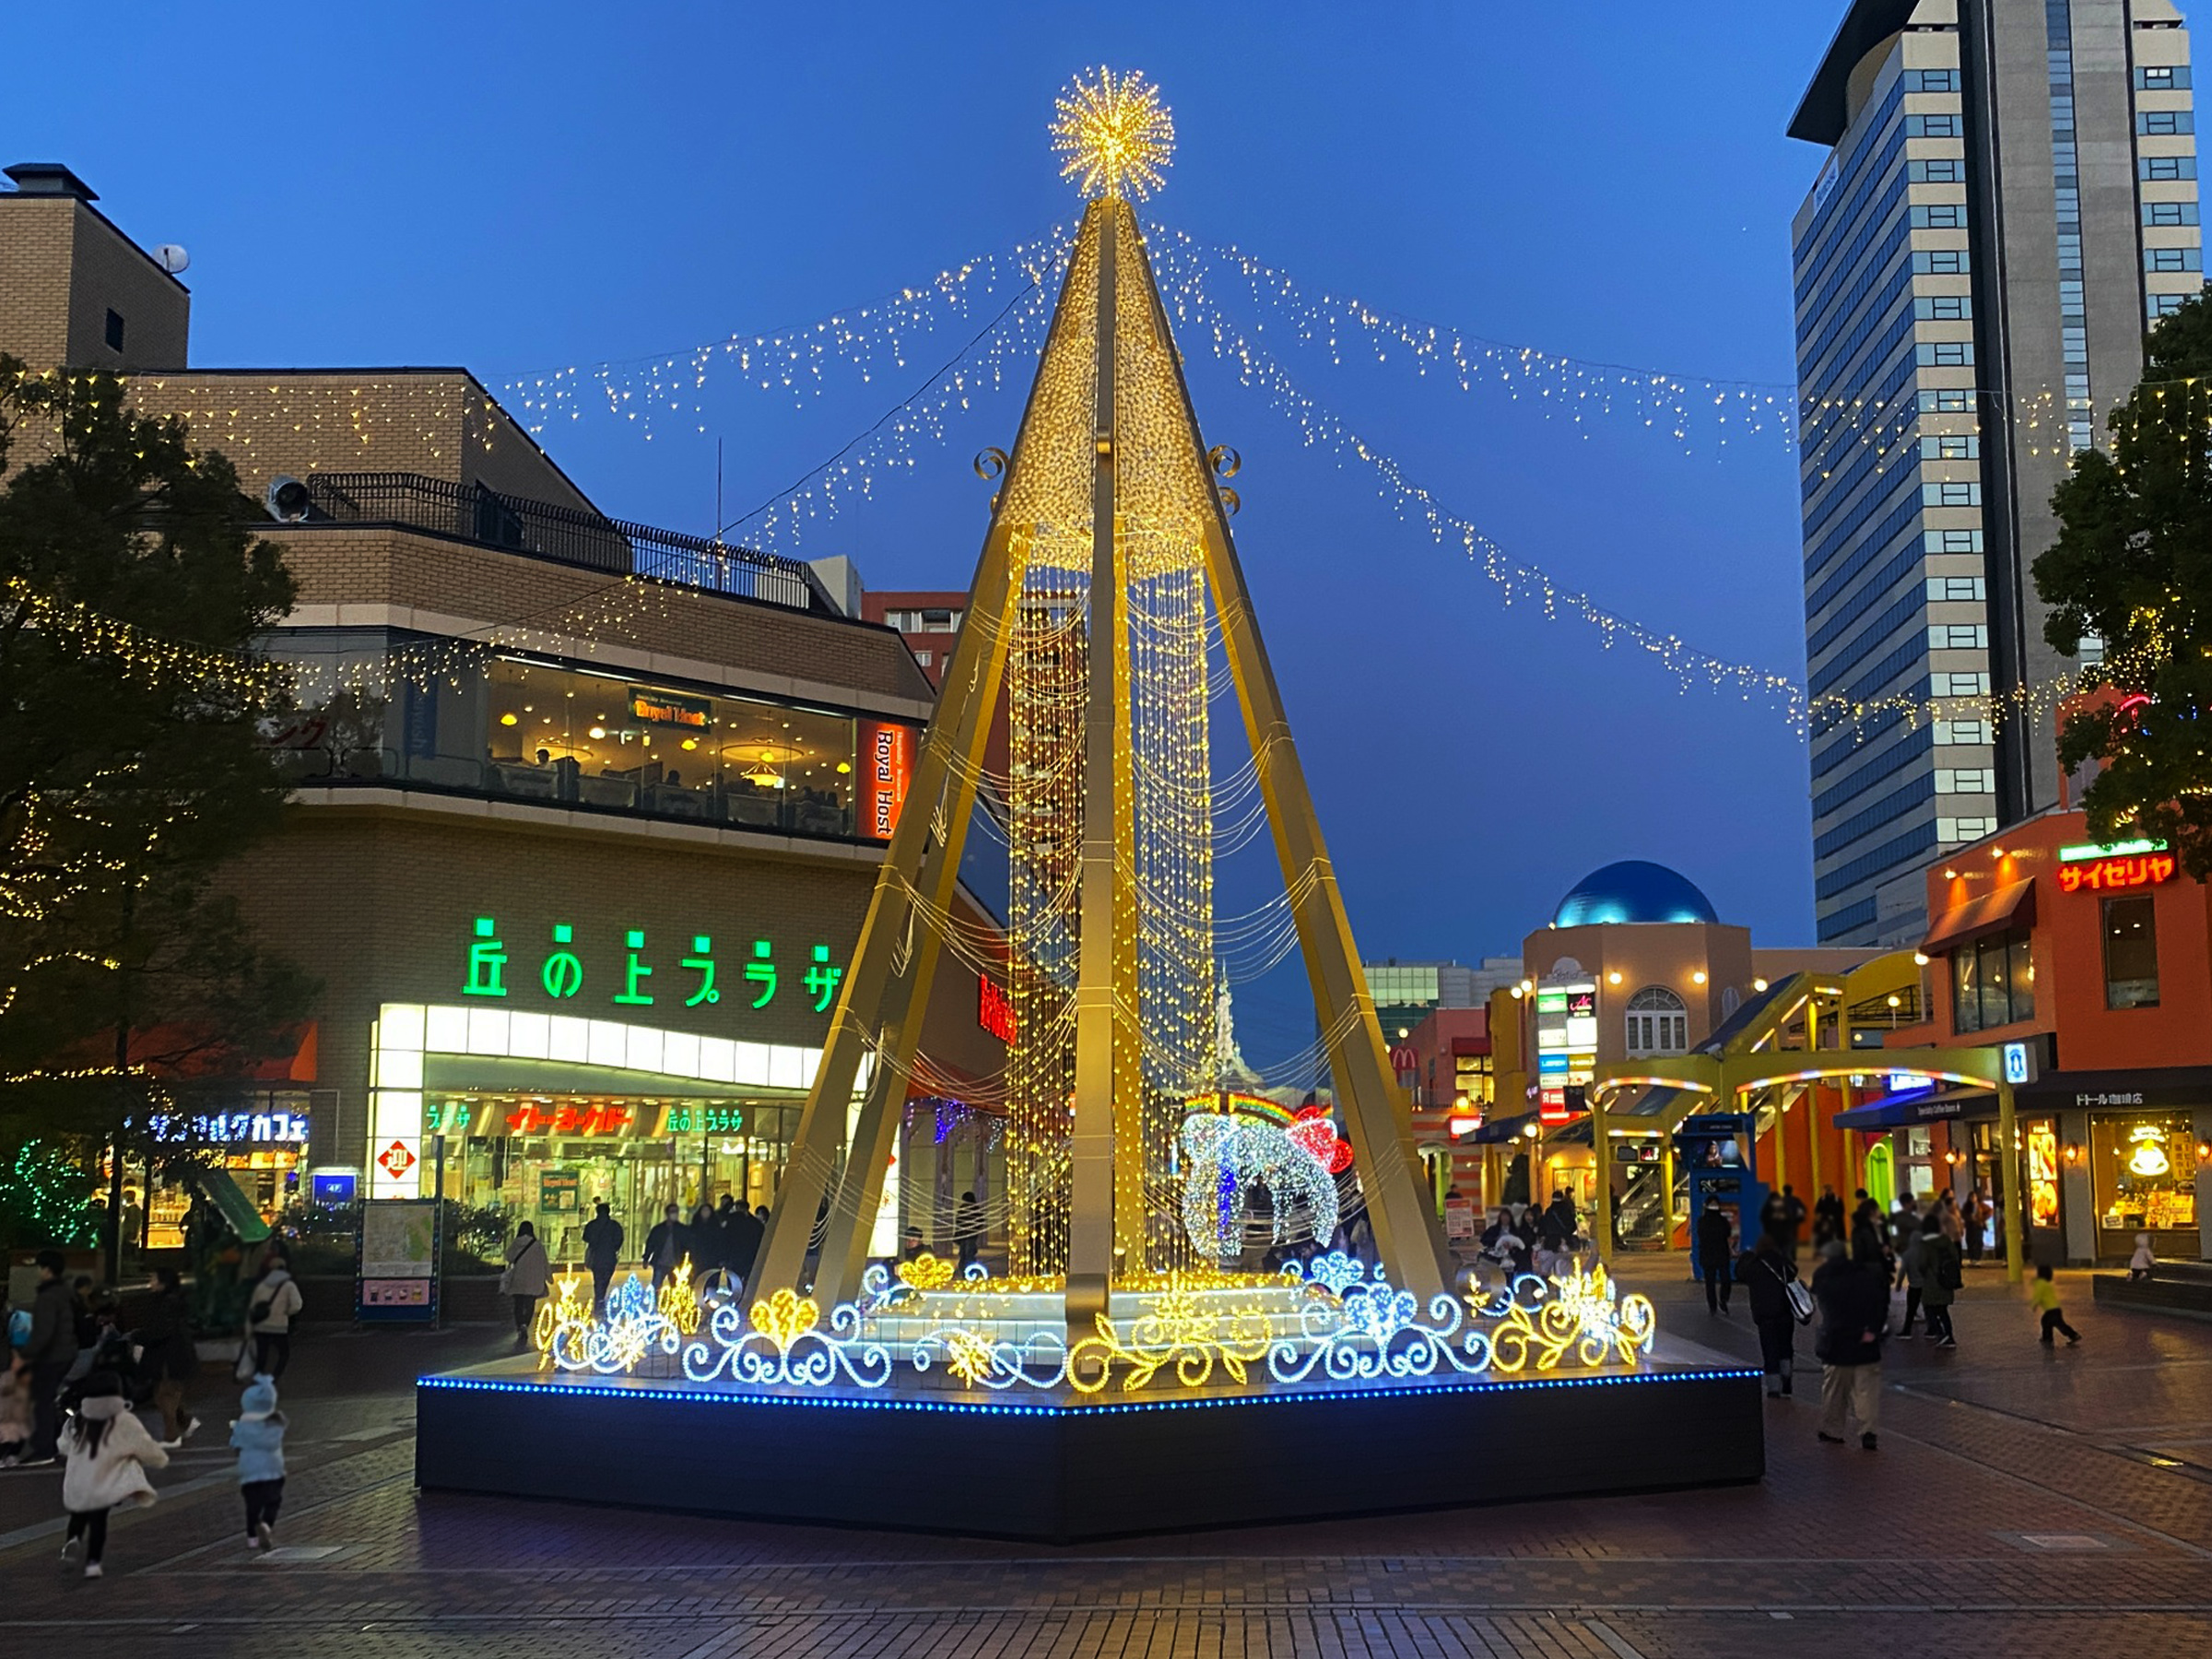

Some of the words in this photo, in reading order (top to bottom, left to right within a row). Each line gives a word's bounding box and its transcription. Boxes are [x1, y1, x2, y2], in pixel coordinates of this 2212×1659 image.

[874, 731, 894, 782] Royal
[876, 791, 893, 835] Host
[2059, 856, 2173, 892] サイゼリヤ
[463, 935, 842, 1013] 丘の上プラザ
[666, 1112, 744, 1133] 丘の上プラザ
[385, 1147, 408, 1171] 迎
